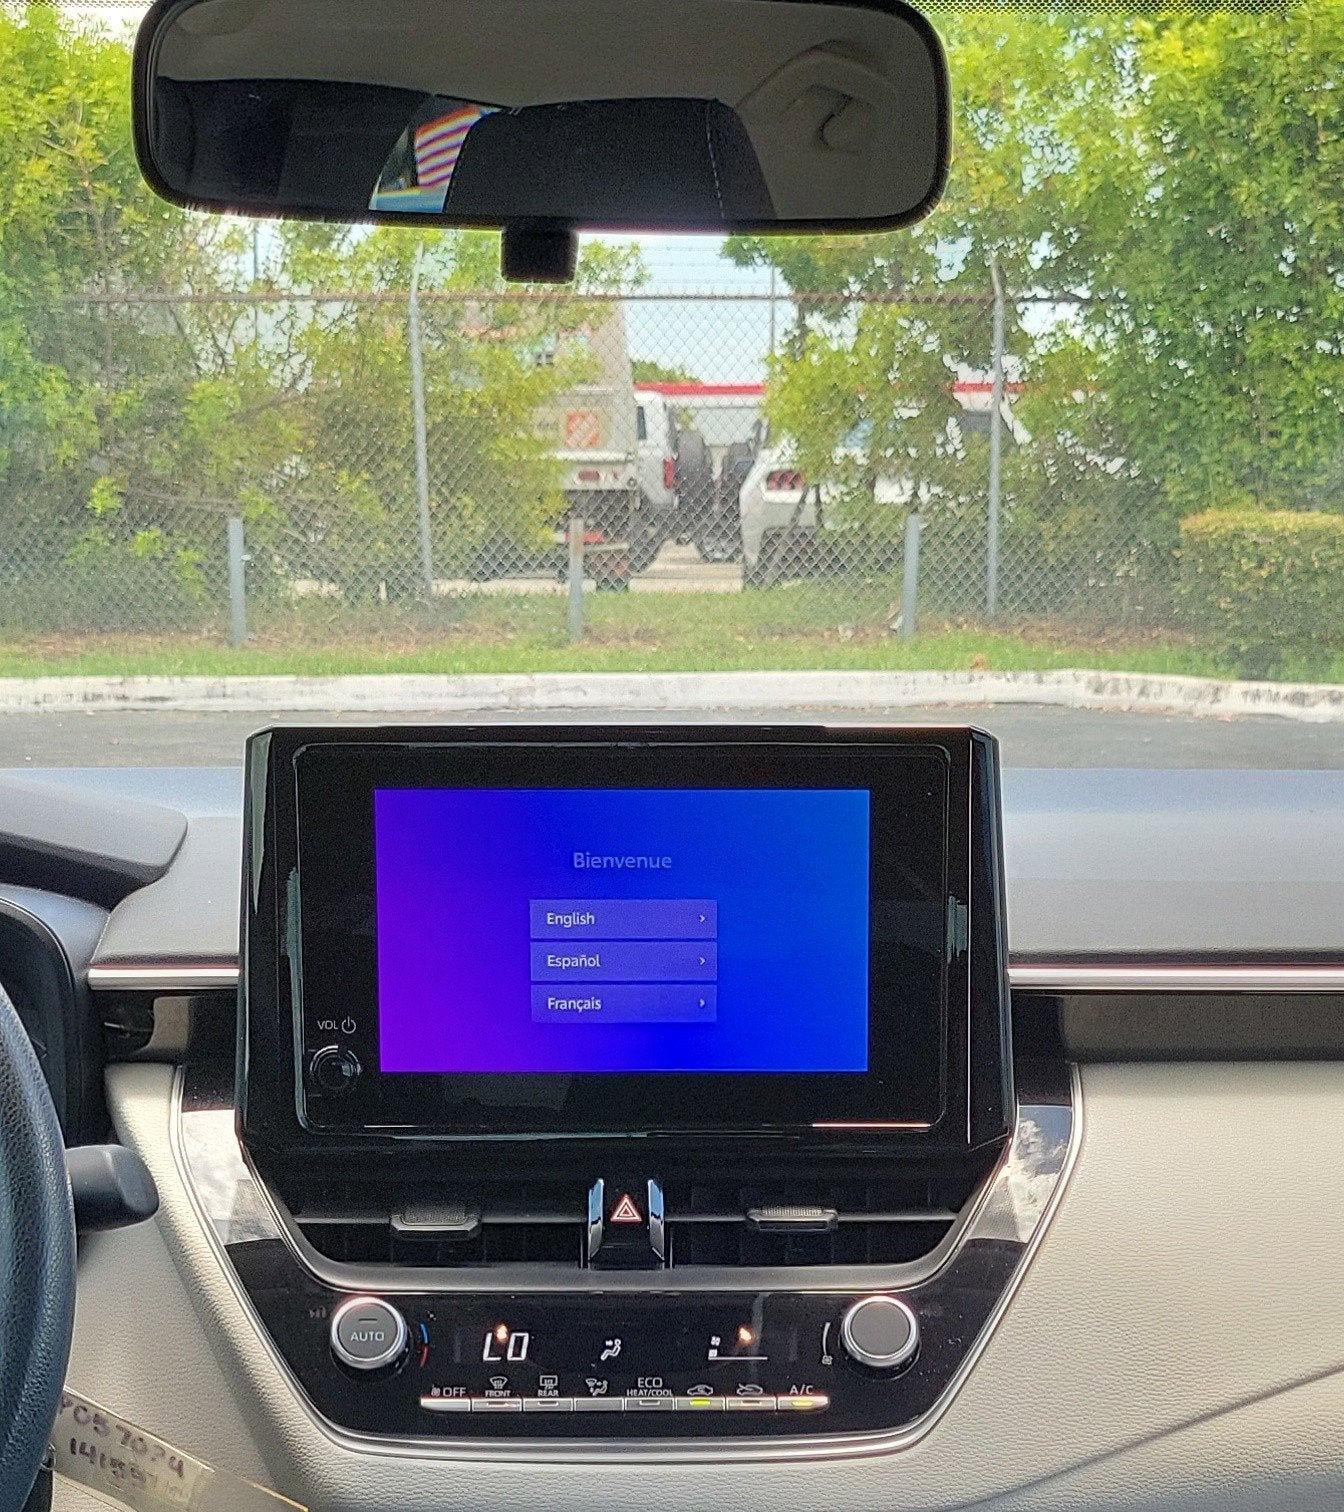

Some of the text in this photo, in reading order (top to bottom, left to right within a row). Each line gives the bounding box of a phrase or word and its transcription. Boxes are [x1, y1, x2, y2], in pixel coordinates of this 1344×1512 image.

[572, 851, 673, 870] Bienvenue
[546, 912, 596, 929] English
[546, 954, 602, 970] Español
[547, 996, 603, 1013] Français
[317, 1020, 339, 1030] VOL
[350, 1331, 385, 1342] AUTO
[483, 1332, 530, 1362] LO
[637, 1377, 664, 1388] ECO
[442, 1387, 467, 1397] OFF
[485, 1389, 512, 1397] FRONT
[537, 1389, 560, 1397] REAR
[626, 1389, 675, 1397] HEAT/COOL
[789, 1384, 815, 1396] A/C
